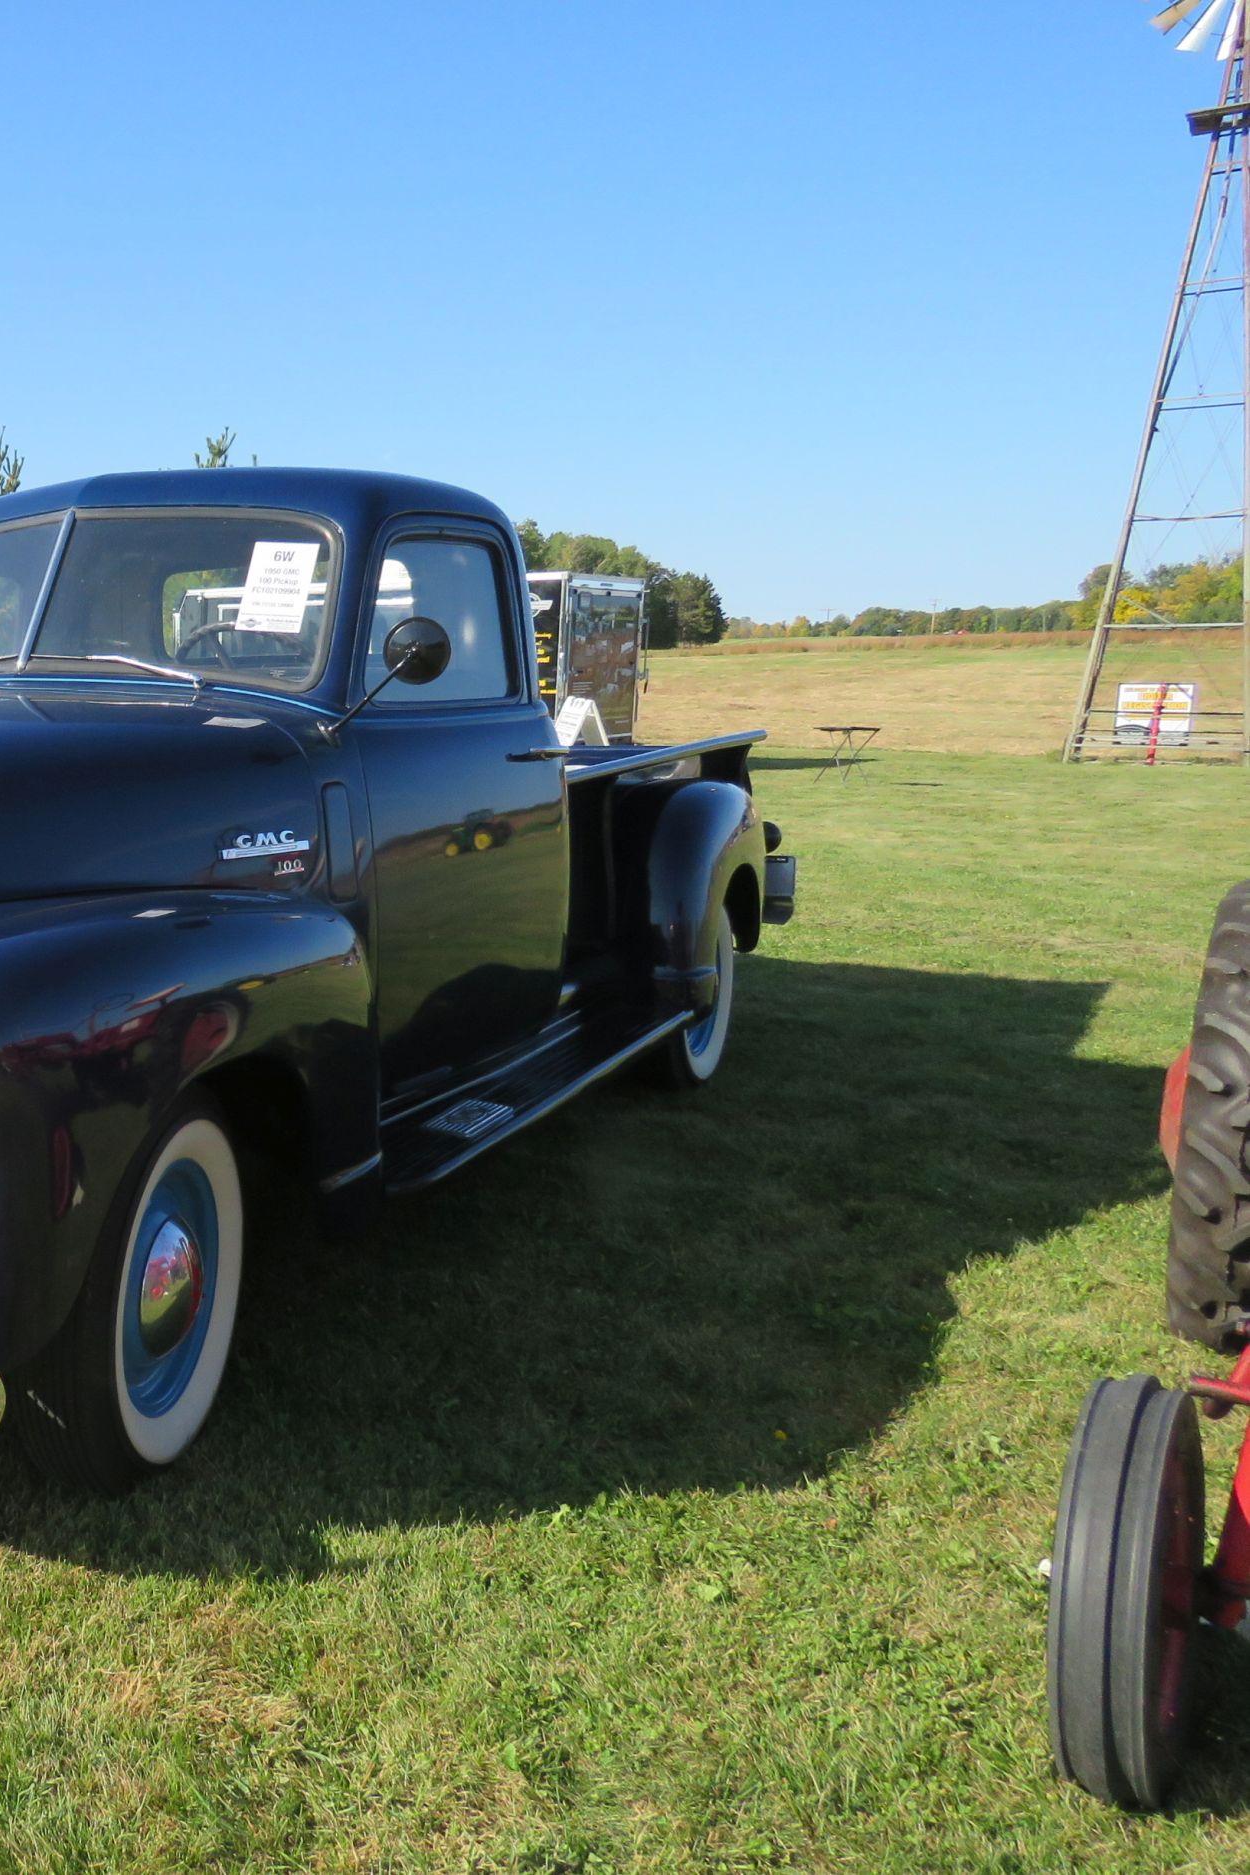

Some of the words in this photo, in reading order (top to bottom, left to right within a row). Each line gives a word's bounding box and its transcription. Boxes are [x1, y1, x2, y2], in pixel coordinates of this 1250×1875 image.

[273, 550, 296, 562] 6W
[282, 568, 300, 576] GMC
[259, 576, 272, 584] 100
[273, 577, 299, 586] Pickup
[235, 830, 295, 849] GMC
[276, 859, 303, 873] 100
